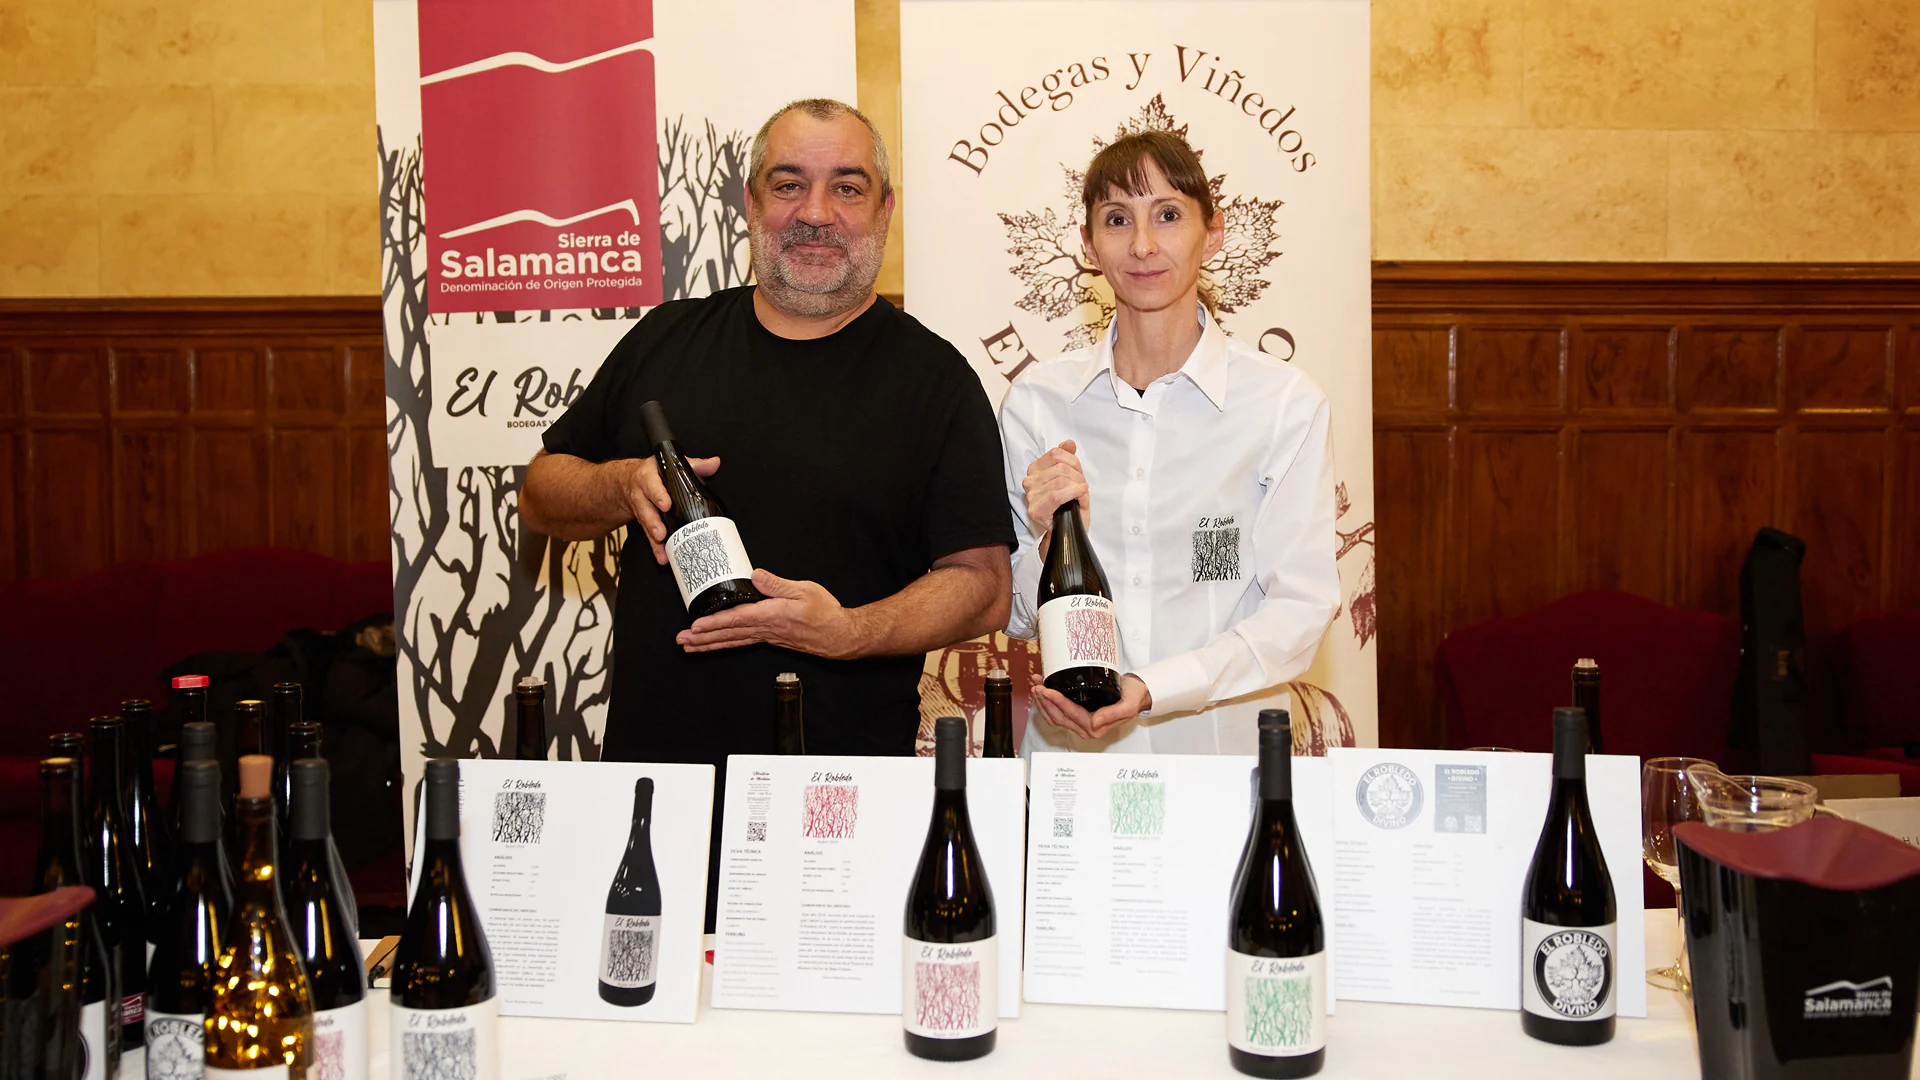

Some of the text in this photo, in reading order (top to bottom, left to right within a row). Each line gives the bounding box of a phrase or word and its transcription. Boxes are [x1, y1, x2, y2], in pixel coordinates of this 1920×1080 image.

[947, 44, 1316, 178] Bodegas y Viñedos
[558, 231, 640, 248] Sierra de
[441, 247, 642, 278] Salamanca
[441, 276, 642, 293] Denominación de Origen Protegida
[446, 366, 587, 417] El Rob
[507, 420, 547, 428] BODEGAS
[1199, 517, 1210, 528] El
[673, 520, 709, 545] El Robledo
[1071, 597, 1081, 607] El
[811, 771, 853, 783] El Robledo
[1116, 769, 1159, 780] El Robledo
[1363, 765, 1417, 786] EL ROBLEDO
[502, 779, 541, 790] El Robledo
[1372, 816, 1407, 828] DIVINO
[921, 946, 972, 960] El Robledo
[1540, 932, 1608, 958] EL ROBLEDO
[1251, 960, 1305, 974] El Robledo
[1553, 999, 1598, 1016] DIVINO
[1804, 997, 1891, 1013] Salamanca
